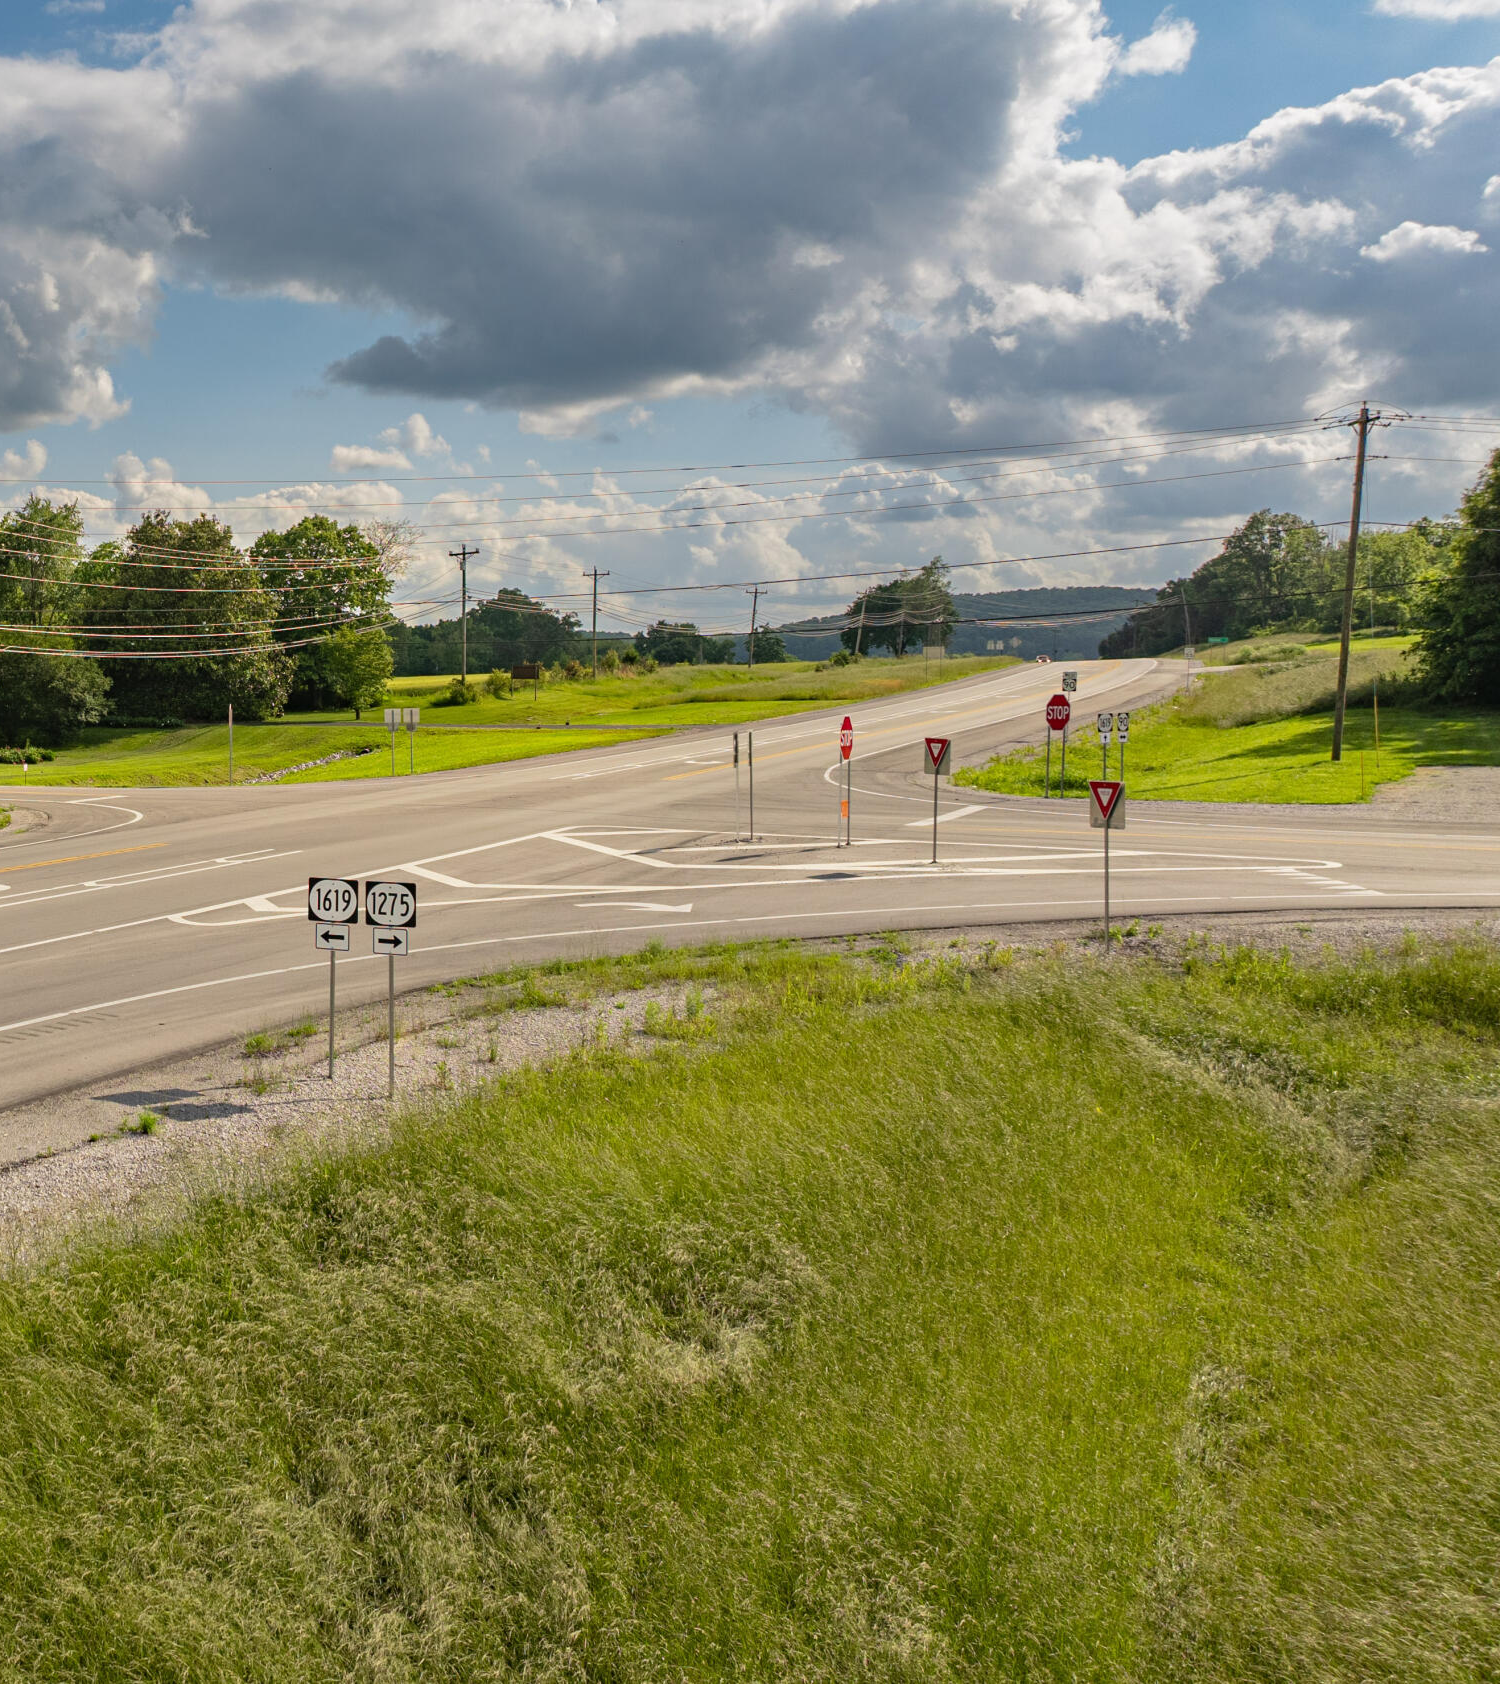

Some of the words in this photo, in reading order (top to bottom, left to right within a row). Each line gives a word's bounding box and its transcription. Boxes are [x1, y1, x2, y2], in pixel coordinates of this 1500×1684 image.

[1047, 706, 1069, 720] STOP
[840, 730, 852, 746] STOP
[316, 888, 351, 912] 1619
[371, 892, 409, 916] 1275
